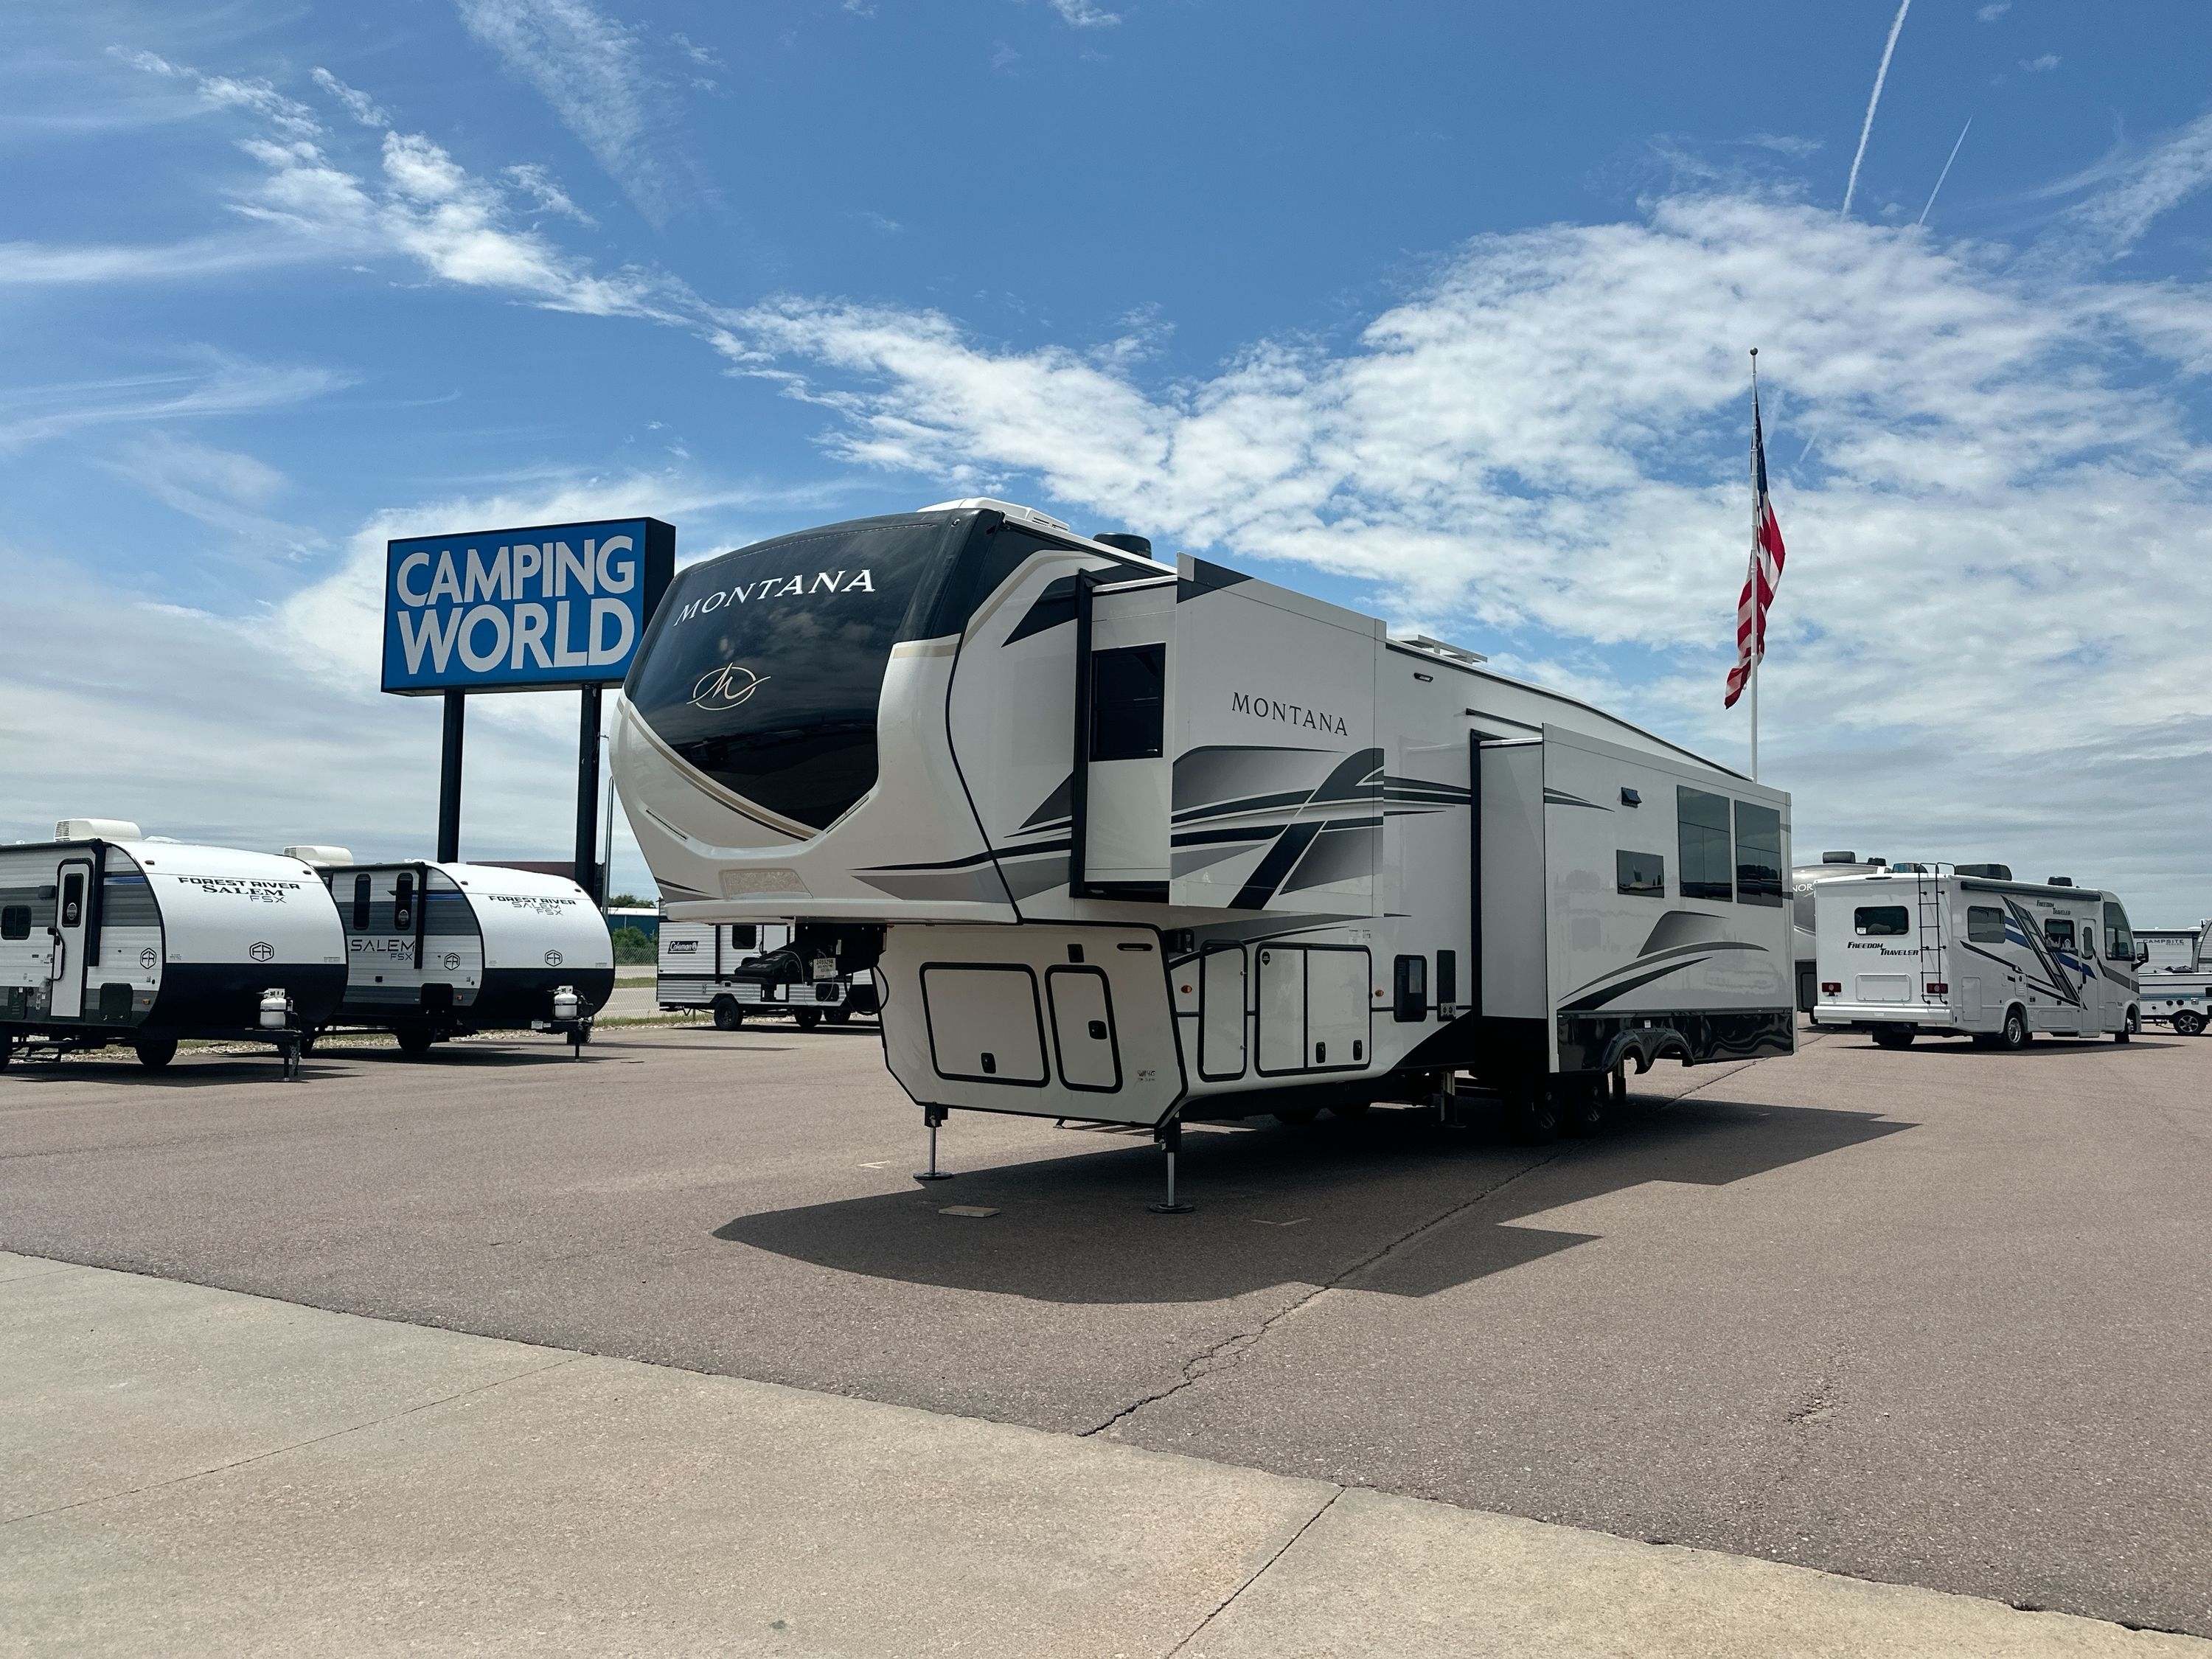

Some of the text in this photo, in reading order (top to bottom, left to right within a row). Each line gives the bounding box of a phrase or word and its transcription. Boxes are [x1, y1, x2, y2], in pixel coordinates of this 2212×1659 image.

[397, 535, 635, 608] CAMPING
[673, 569, 876, 627] MONTANA
[397, 597, 635, 675] WORLD
[1231, 692, 1348, 737] MONTANA
[178, 877, 301, 889] FOREST RIVER
[202, 885, 285, 897] SALEM
[249, 895, 287, 903] FSX
[512, 901, 561, 910] SALEM
[350, 939, 415, 952] SALEM
[670, 942, 692, 951] Coleman
[1847, 941, 1884, 949] FREEDOM
[390, 953, 413, 961] FSX
[1880, 947, 1919, 956] TRAVELER
